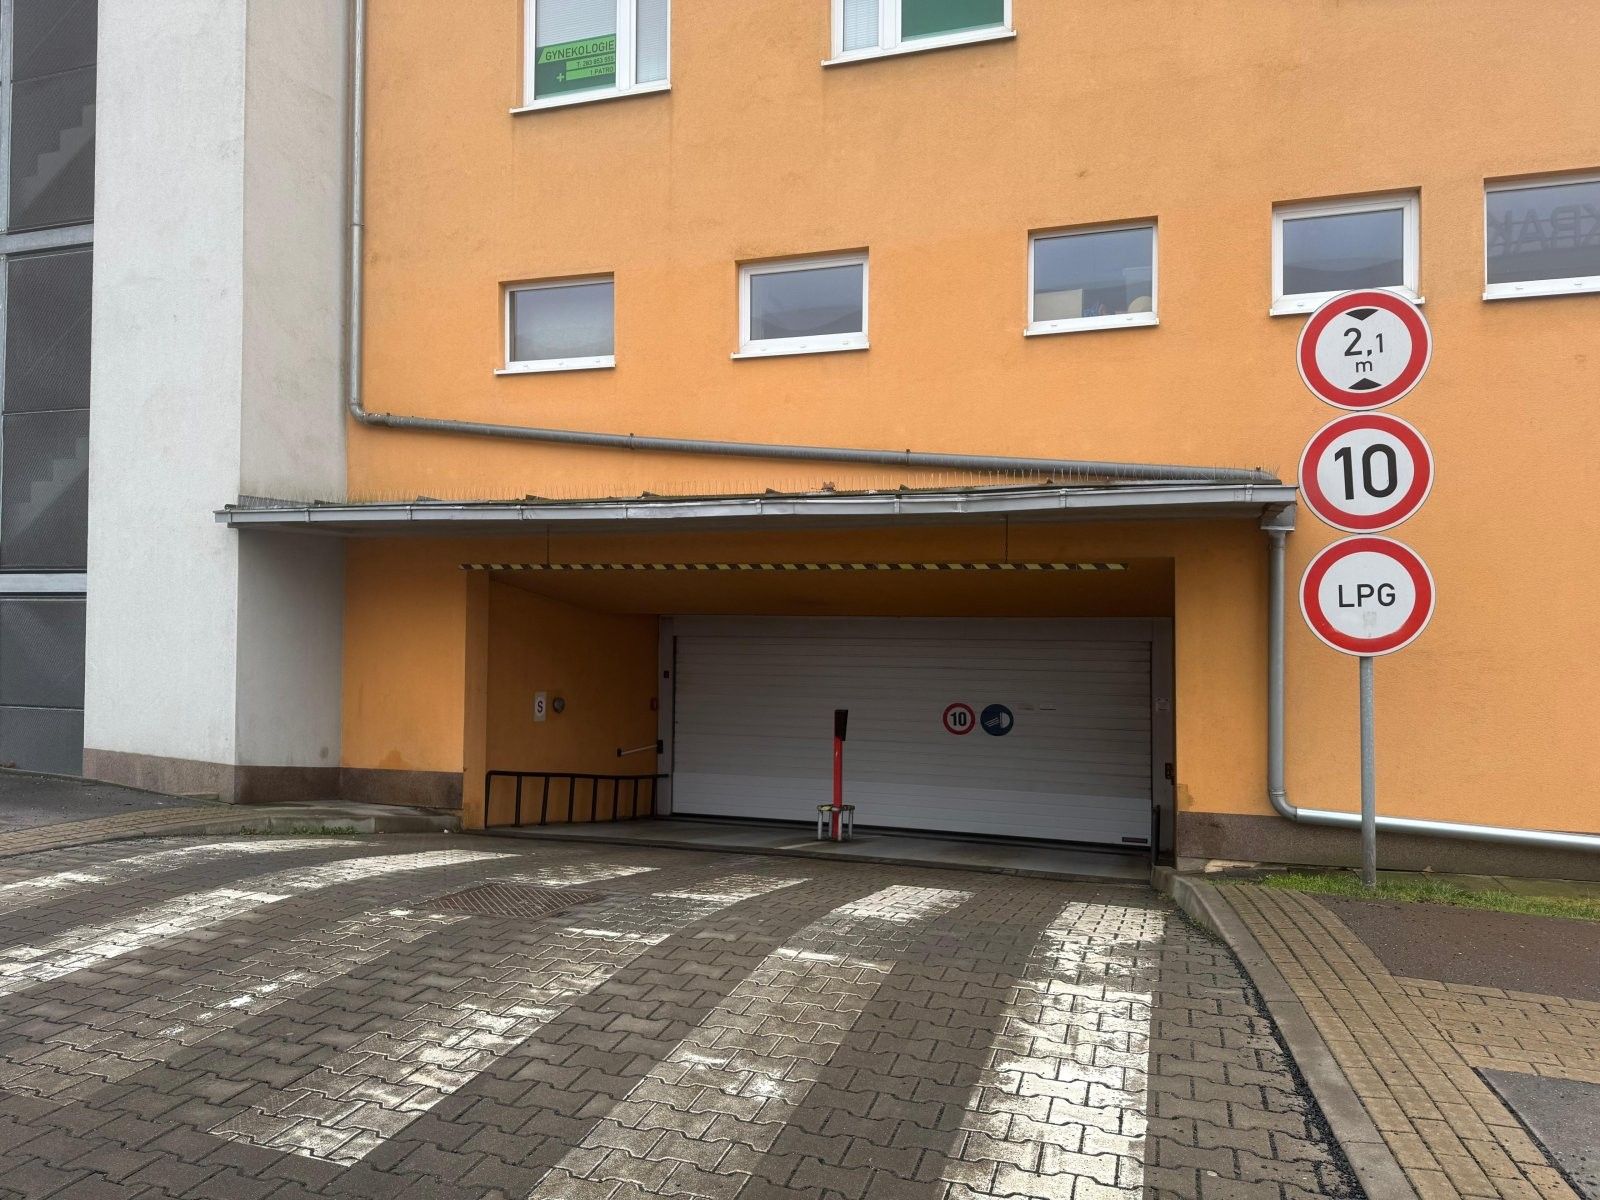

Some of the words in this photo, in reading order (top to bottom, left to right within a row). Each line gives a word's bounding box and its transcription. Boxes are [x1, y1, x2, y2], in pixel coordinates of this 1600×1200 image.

[545, 39, 615, 61] GYNEKOLOGIE
[1343, 327, 1384, 357] 2,1
[1355, 360, 1373, 373] m
[1334, 443, 1398, 501] 10
[1338, 582, 1396, 608] LPG
[536, 700, 544, 714] S
[949, 711, 967, 727] 10
